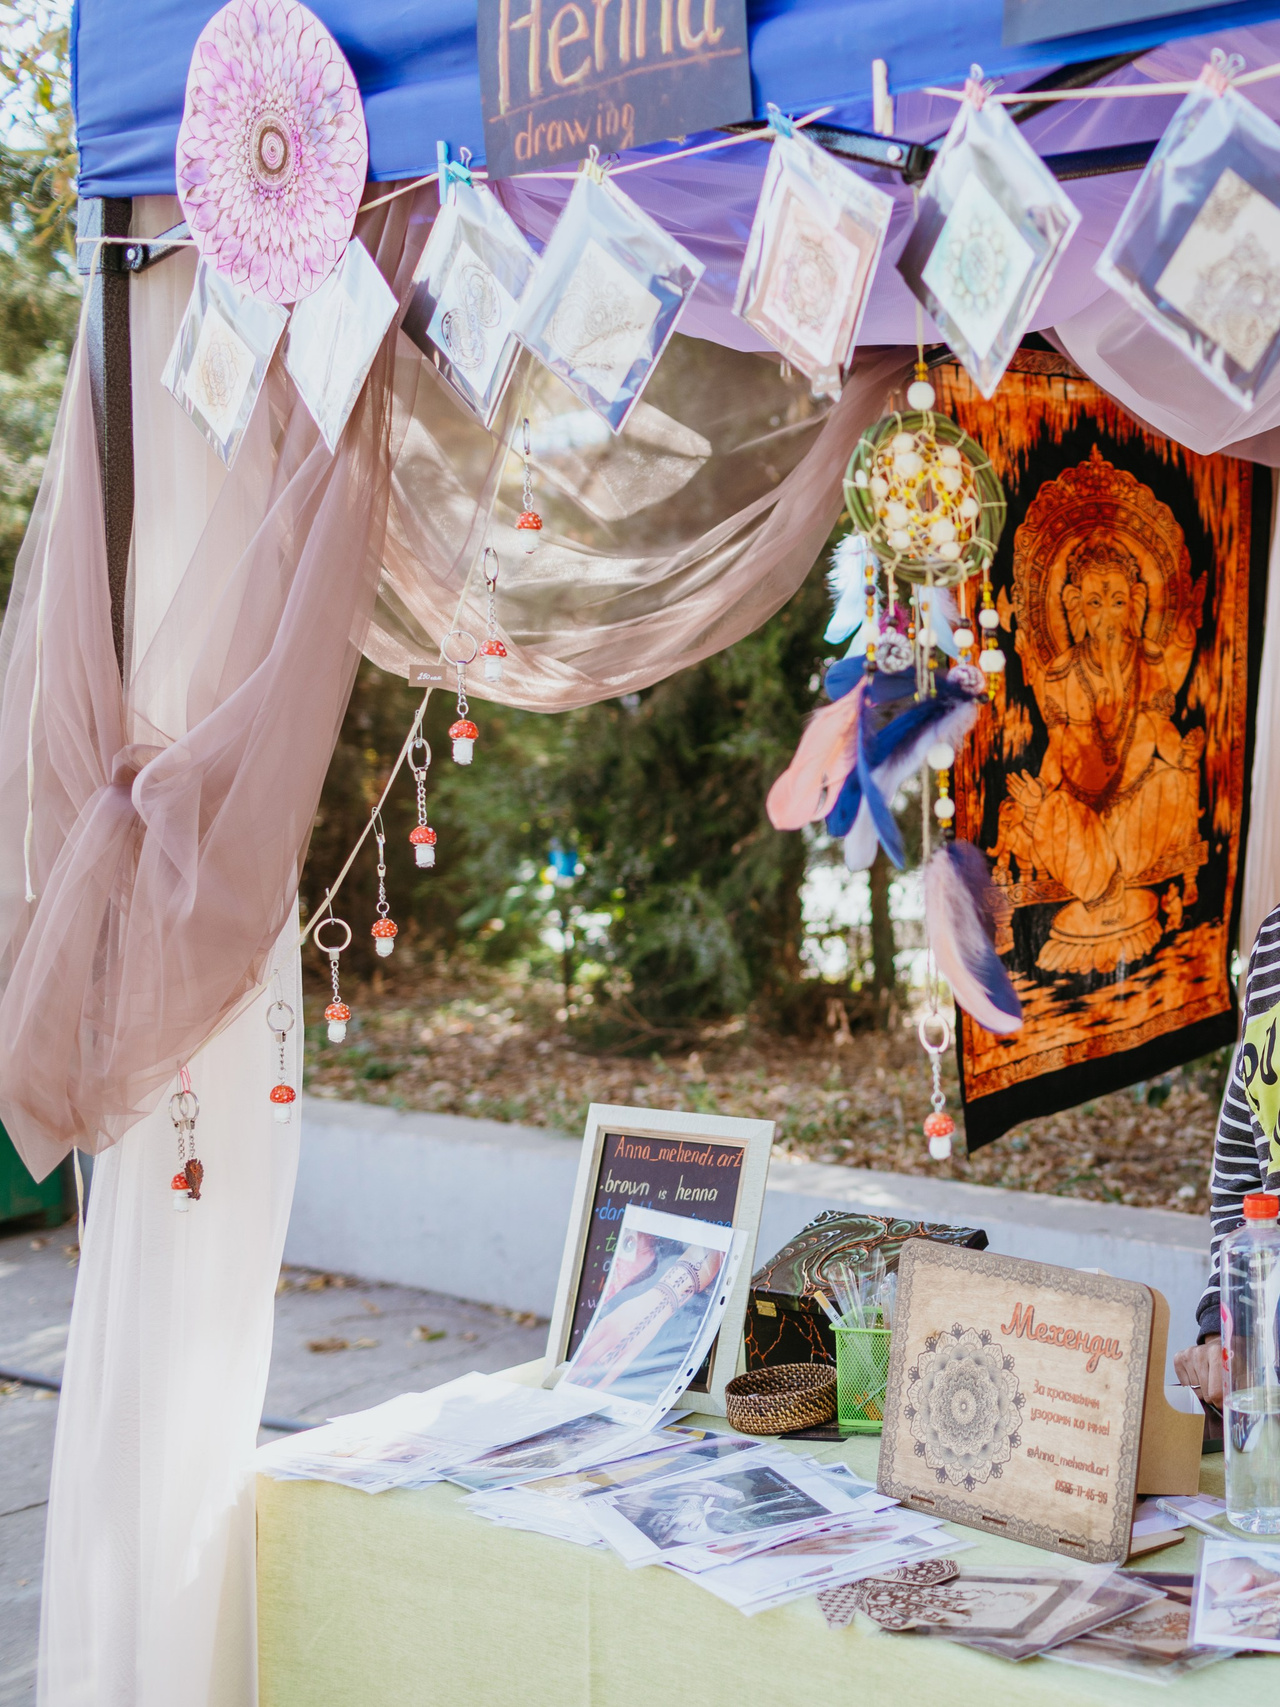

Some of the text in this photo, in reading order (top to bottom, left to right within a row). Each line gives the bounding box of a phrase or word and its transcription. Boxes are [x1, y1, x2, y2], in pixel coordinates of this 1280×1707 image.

[498, 0, 725, 115] Henna
[514, 103, 635, 160] drawing
[614, 1135, 745, 1168] Anna_mehendi.art
[604, 1168, 719, 1201] brown is henna
[1001, 1301, 1124, 1374] Мехенди
[1033, 1379, 1100, 1410] За красивыми
[1073, 1417, 1086, 1430] ко
[1087, 1419, 1110, 1436] мне!
